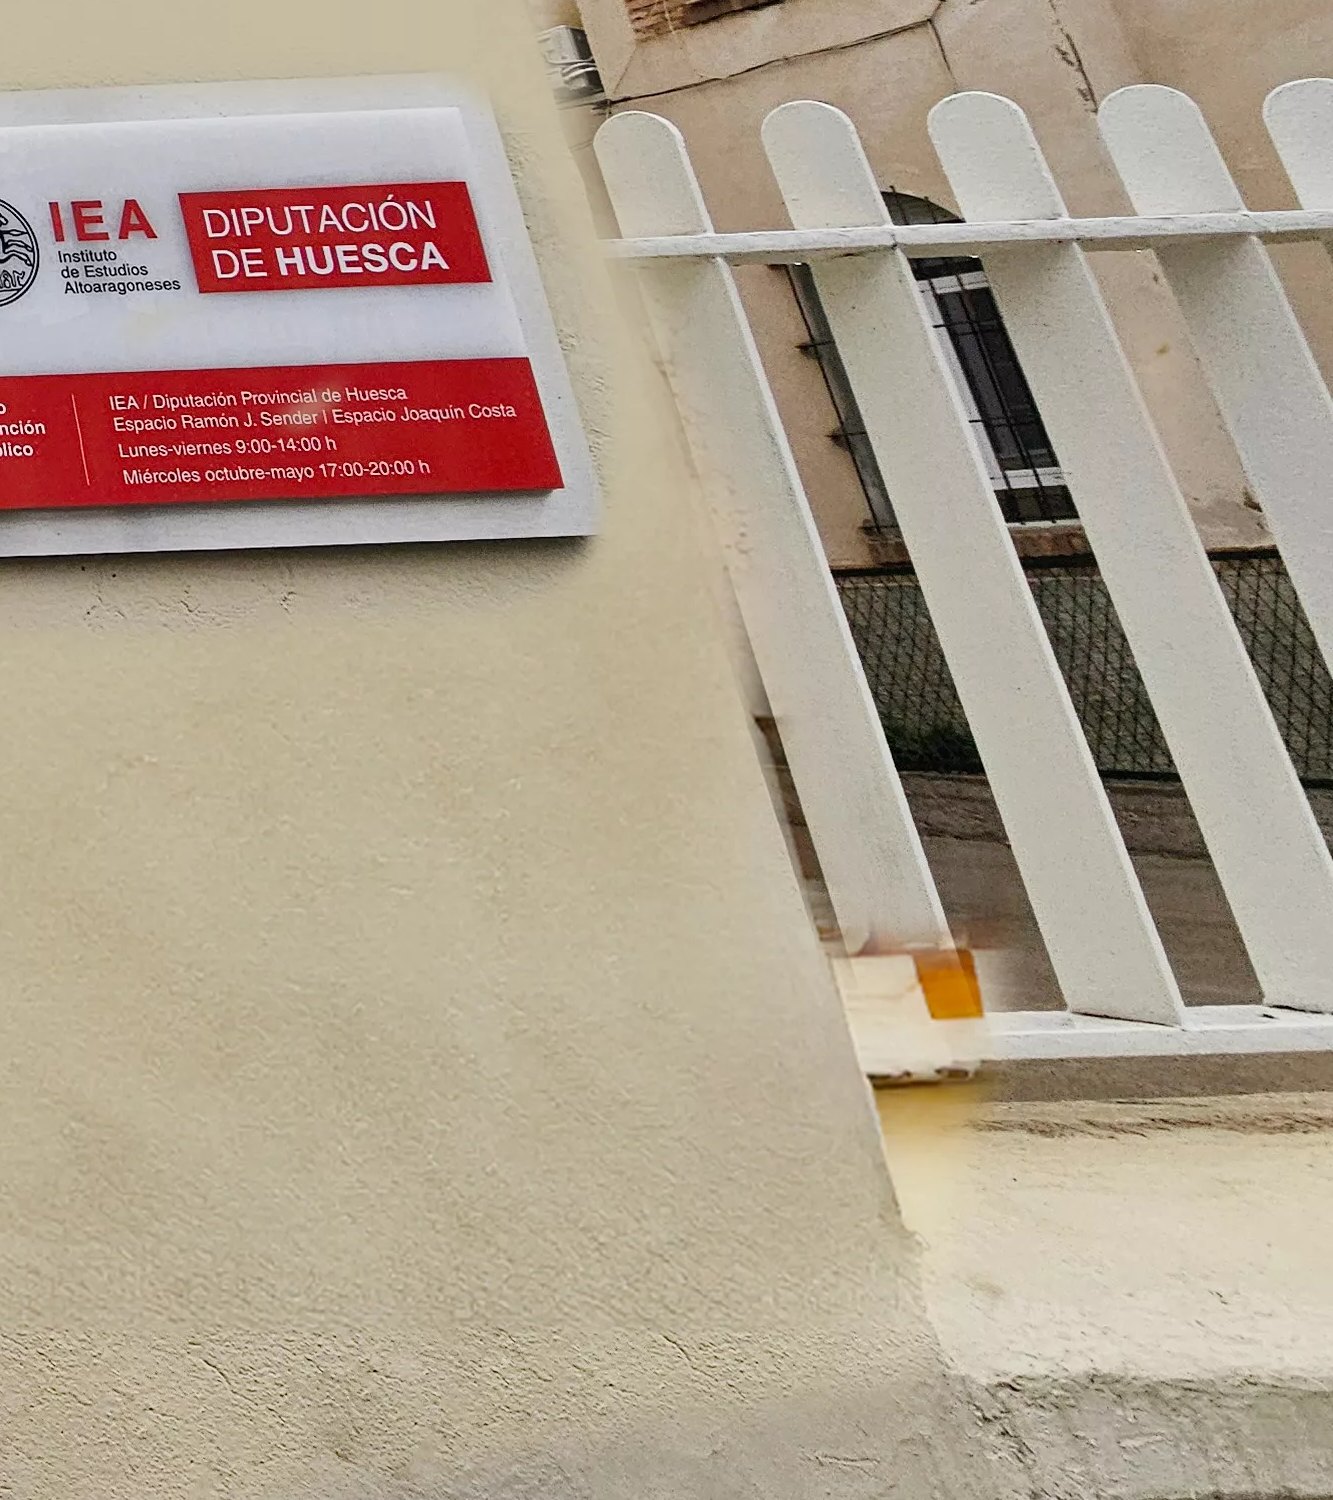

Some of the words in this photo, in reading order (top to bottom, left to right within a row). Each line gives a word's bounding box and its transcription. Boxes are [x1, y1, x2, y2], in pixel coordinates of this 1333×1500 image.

[48, 199, 158, 242] IEA
[202, 194, 437, 238] DIPUTACIÓN
[58, 250, 117, 263] Instituto
[211, 248, 268, 279] DE
[275, 241, 450, 276] HUESCA
[61, 267, 80, 279] de
[85, 263, 149, 278] Estudios
[64, 278, 181, 295] Altoaragoneses
[109, 395, 140, 411] IEA
[153, 392, 238, 412] Diputación
[240, 388, 317, 407] Provincial
[321, 388, 342, 403] de
[344, 387, 408, 402] Huesca
[113, 416, 177, 434] Espacio
[180, 413, 240, 429] Ramón
[243, 413, 257, 428] J.
[261, 410, 317, 426] Sender
[331, 408, 396, 427] Espacio
[400, 404, 465, 424] Joaquín
[468, 403, 517, 419] Costa
[118, 440, 232, 458] Lunes-viernes
[235, 437, 322, 454] 9:00-14:00
[324, 436, 337, 451] h
[122, 468, 201, 485] Miércoles
[205, 465, 315, 483] octubre-mayo
[319, 460, 414, 477] 17:00-20:00
[417, 459, 431, 474] h
